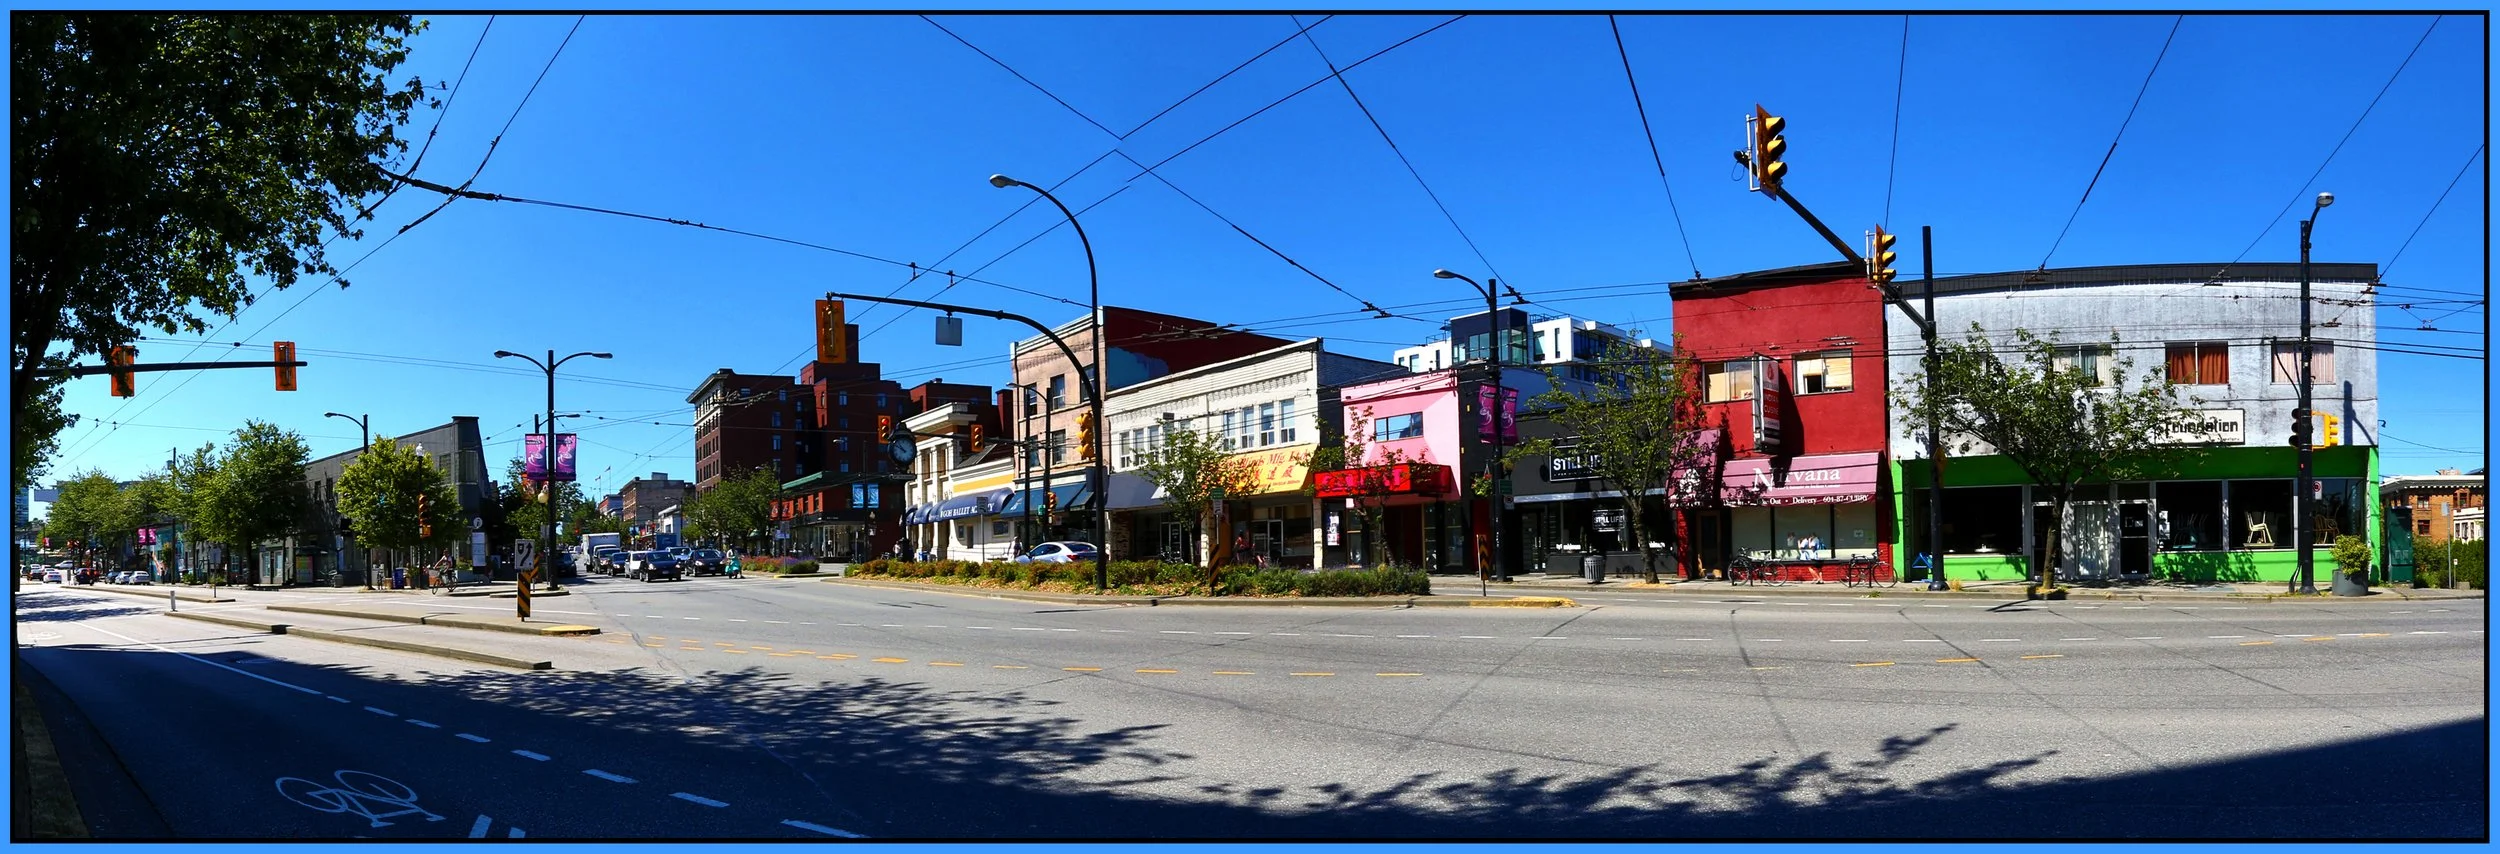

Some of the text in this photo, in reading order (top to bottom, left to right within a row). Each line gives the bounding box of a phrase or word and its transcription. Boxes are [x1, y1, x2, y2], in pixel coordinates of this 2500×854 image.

[1553, 455, 1582, 470] STILL
[1752, 467, 1841, 491] Nirvana
[1769, 497, 1781, 505] Out
[1792, 496, 1817, 505] Delivery
[953, 507, 970, 516] BALLET
